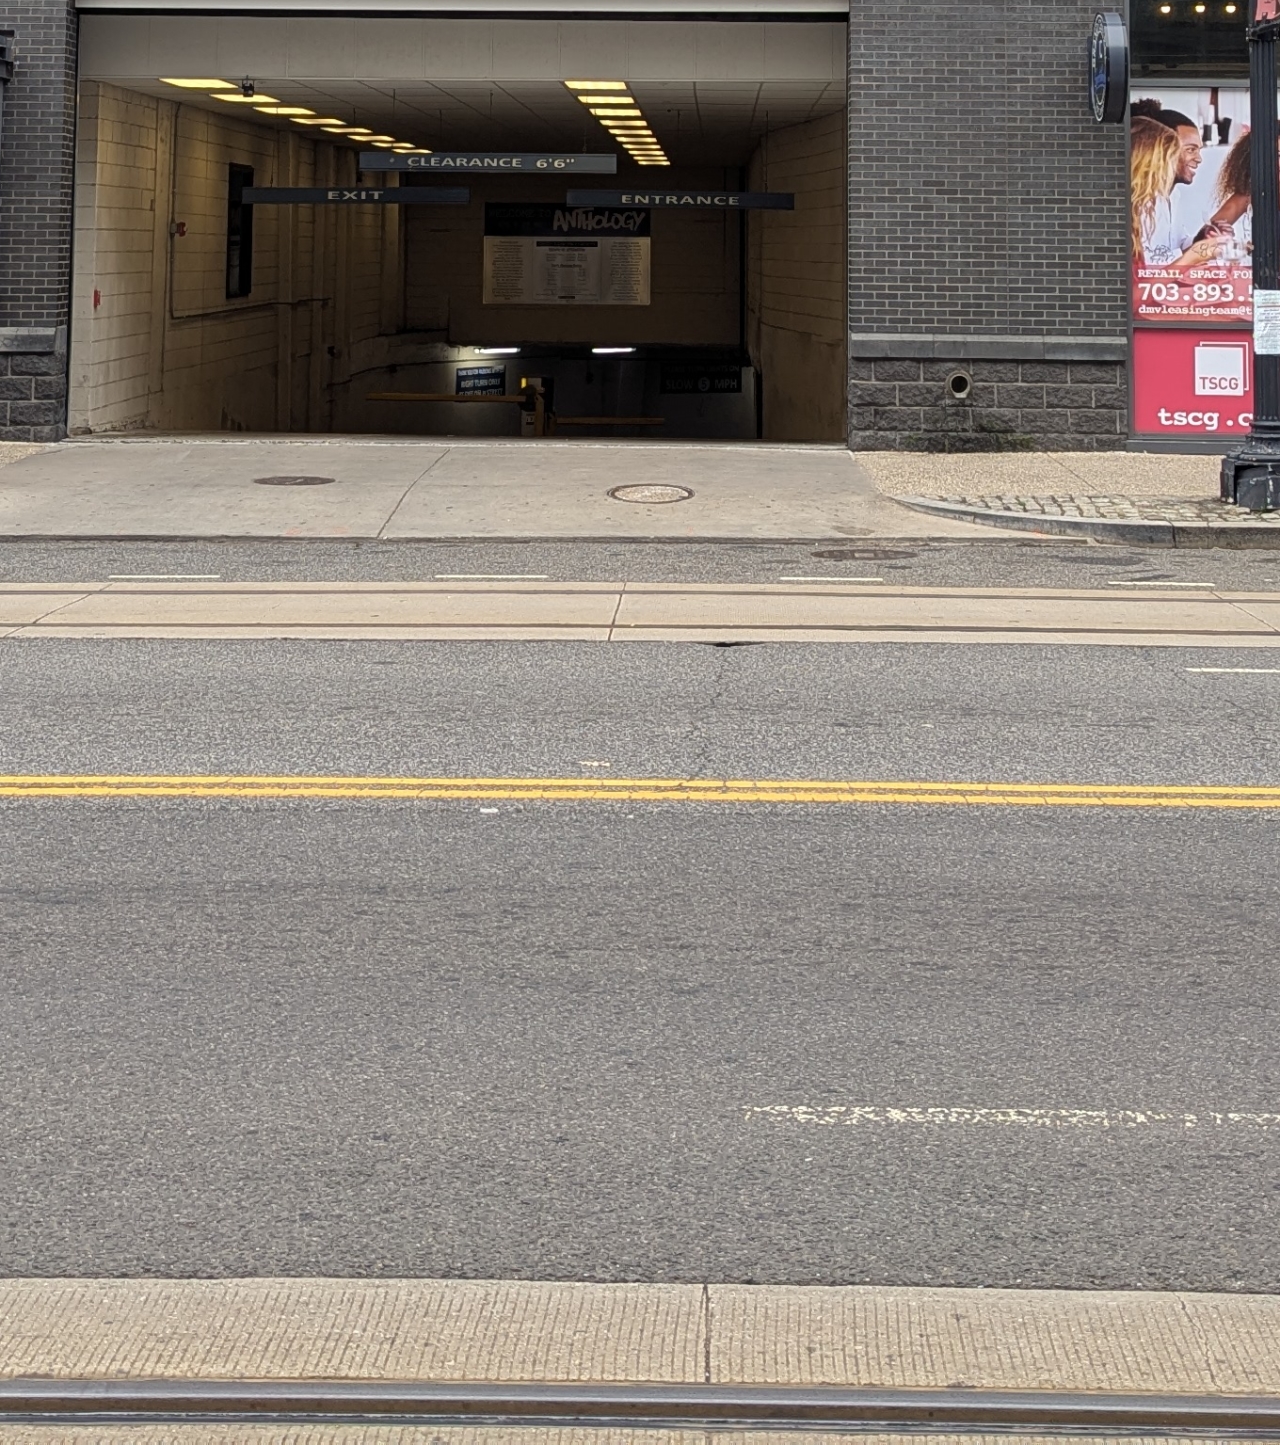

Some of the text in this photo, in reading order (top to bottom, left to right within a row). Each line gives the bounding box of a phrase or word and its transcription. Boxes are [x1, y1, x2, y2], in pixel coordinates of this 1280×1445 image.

[407, 156, 576, 169] CLEARANCE 6'6"
[326, 190, 384, 201] EXIT
[620, 193, 741, 206] ENTRANCE
[552, 207, 646, 232] ANTHOLOGY
[1137, 269, 1183, 279] RETAIL
[1190, 270, 1227, 279] SPACE
[714, 378, 738, 390] MPH
[1199, 376, 1240, 391] TSCG
